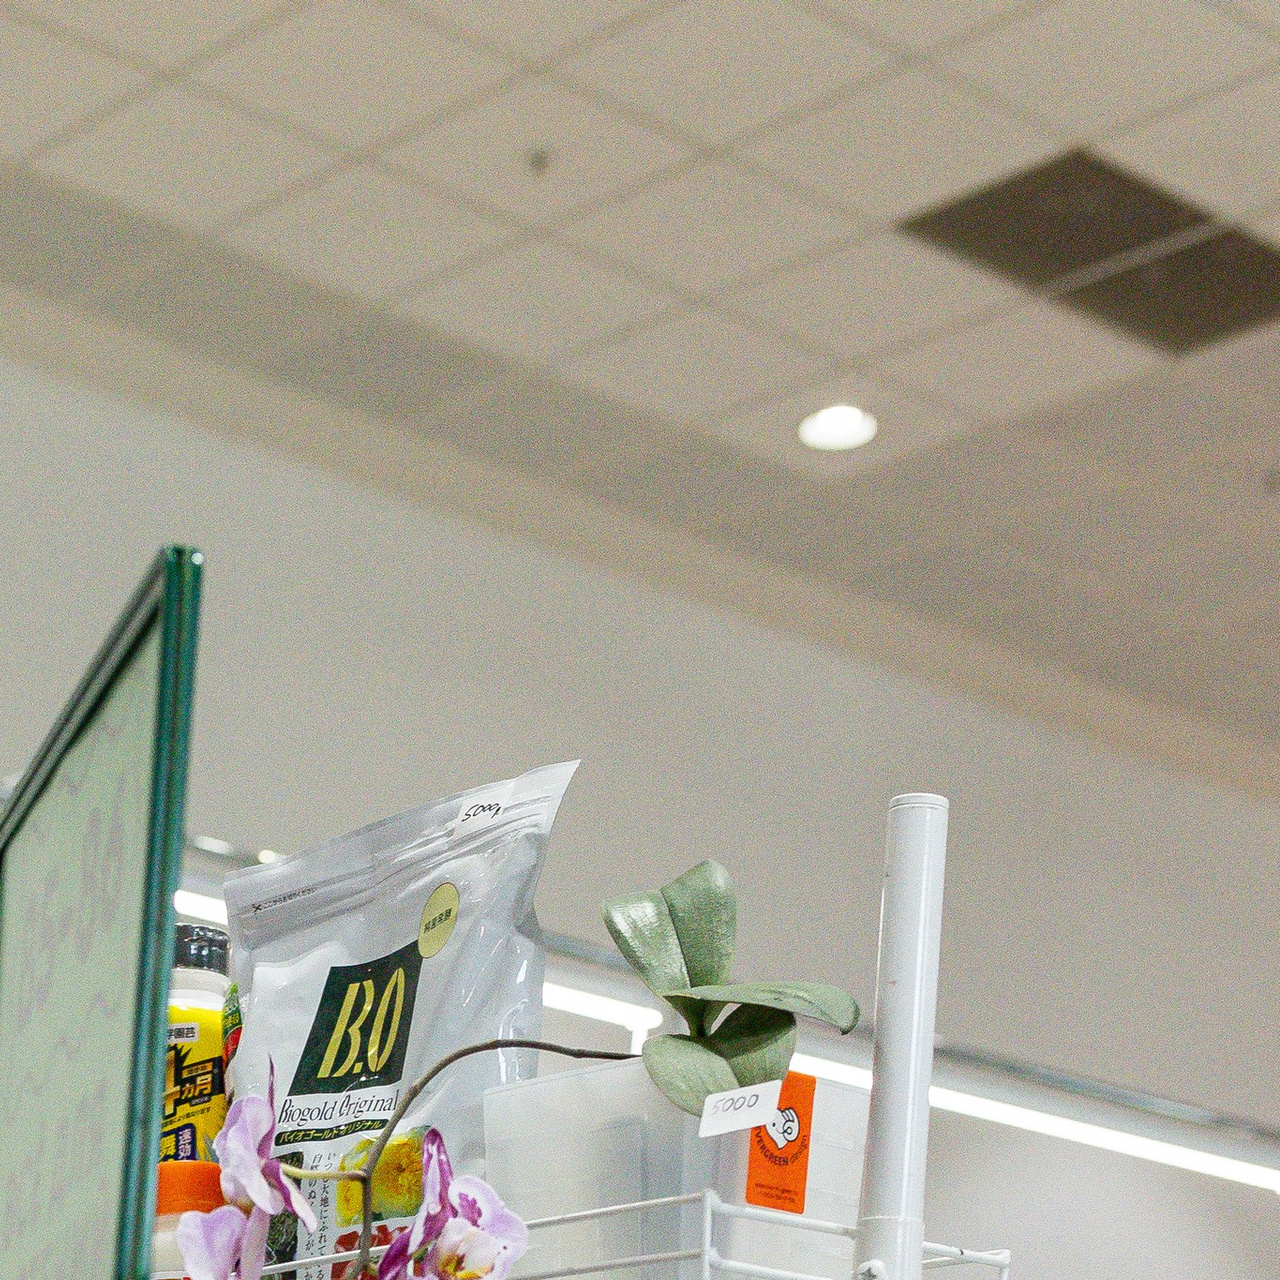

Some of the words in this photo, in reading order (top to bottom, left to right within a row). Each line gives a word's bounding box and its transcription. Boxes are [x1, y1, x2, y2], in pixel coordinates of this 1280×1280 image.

[277, 1096, 336, 1125] Biogold
[338, 1089, 399, 1119] Original
[711, 1093, 761, 1116] 5000
[277, 1118, 386, 1144] バイオゴールドオリジナル
